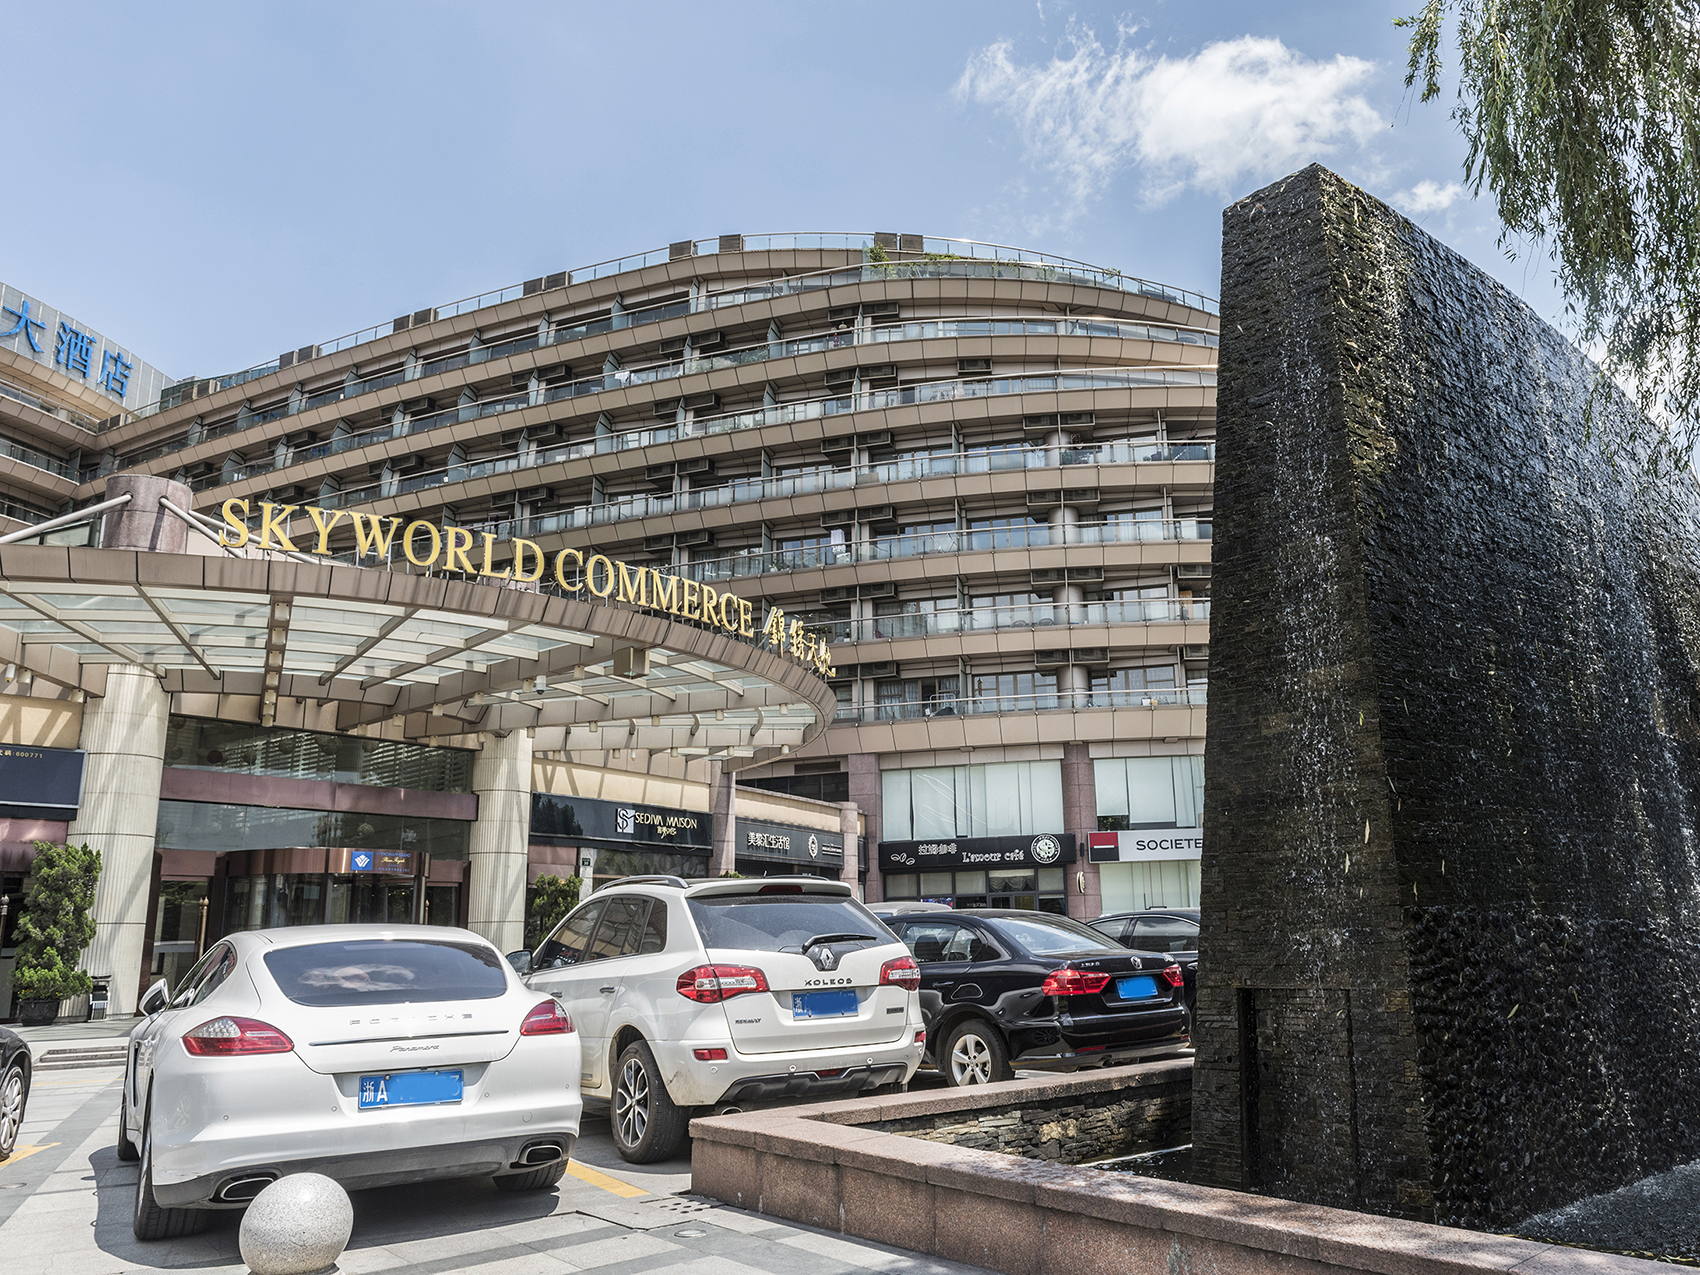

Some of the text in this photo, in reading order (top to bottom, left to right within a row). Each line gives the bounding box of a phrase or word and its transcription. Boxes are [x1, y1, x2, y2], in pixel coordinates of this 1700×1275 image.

[0, 300, 134, 398] 大酒店
[218, 498, 755, 639] SKYWORLD COMMERCE
[634, 811, 698, 829] SEDIVA MAISON
[1003, 848, 1025, 861] café
[804, 977, 853, 987] KOLEOS
